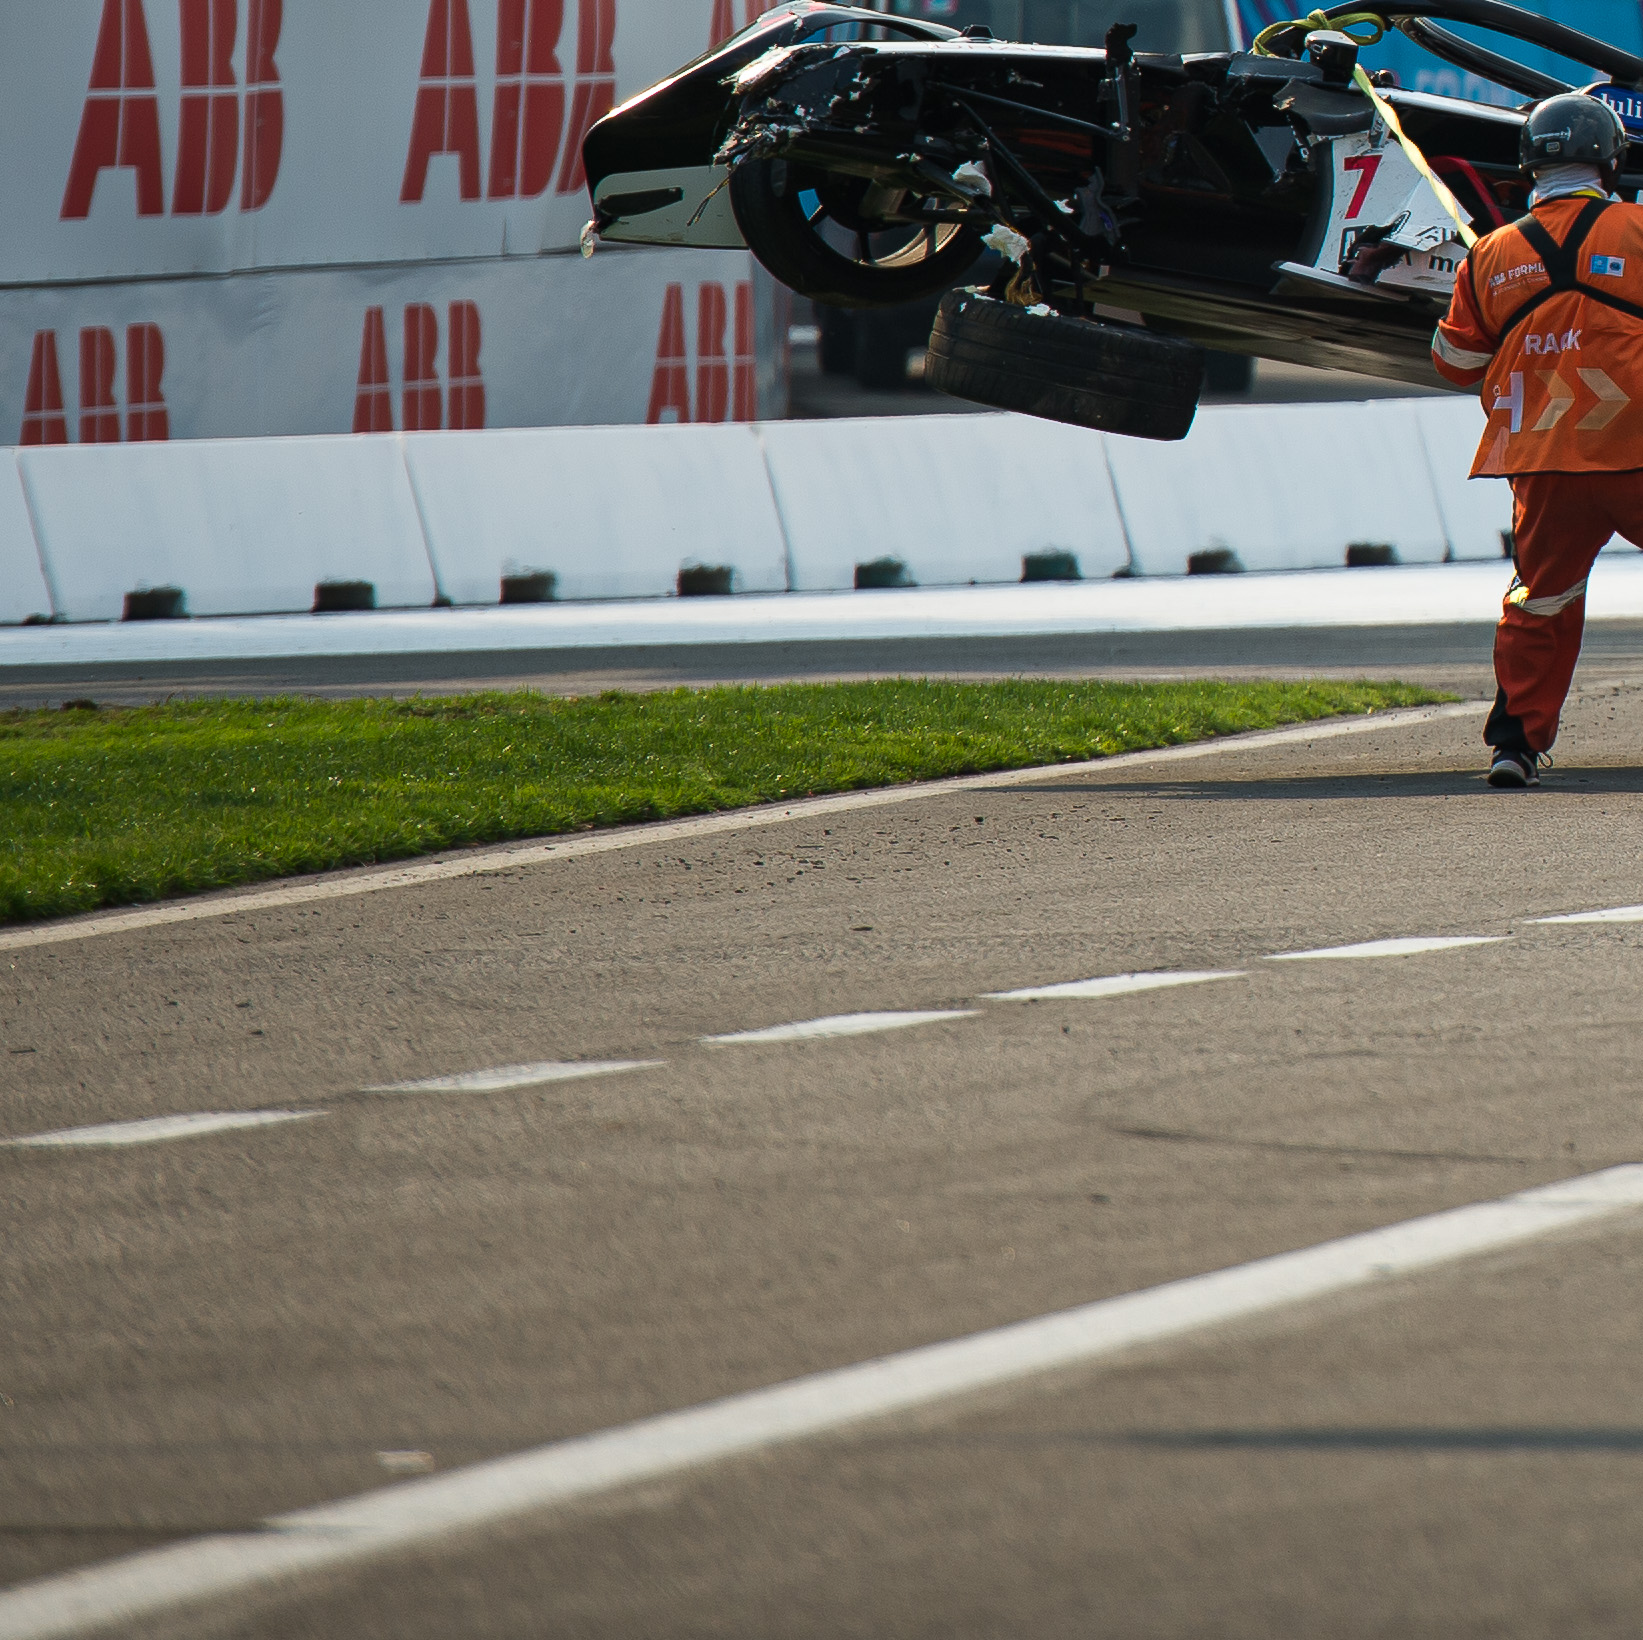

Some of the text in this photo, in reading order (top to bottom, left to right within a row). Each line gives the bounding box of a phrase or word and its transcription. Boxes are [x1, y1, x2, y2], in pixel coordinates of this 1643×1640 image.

[1343, 154, 1383, 220] 7
[20, 321, 171, 447] ABB
[352, 299, 488, 435] ABB
